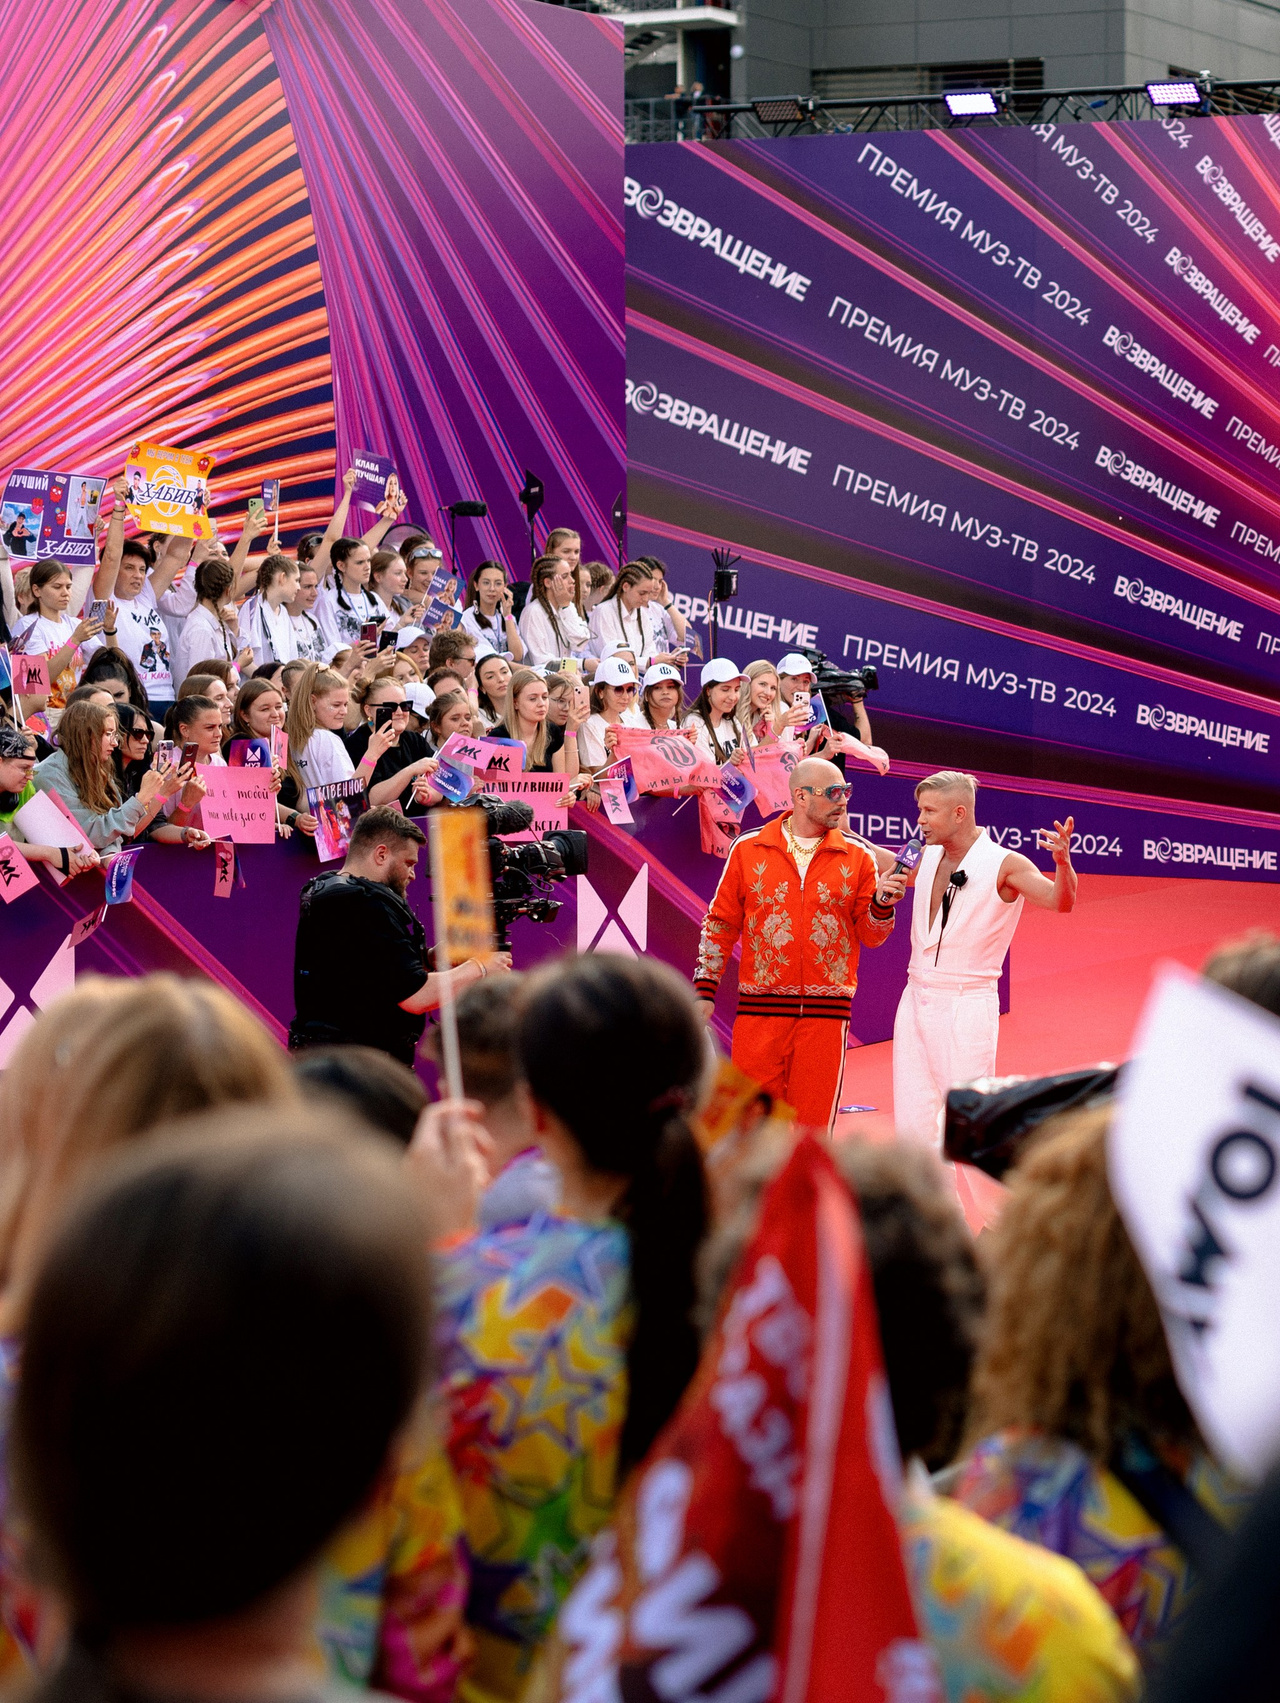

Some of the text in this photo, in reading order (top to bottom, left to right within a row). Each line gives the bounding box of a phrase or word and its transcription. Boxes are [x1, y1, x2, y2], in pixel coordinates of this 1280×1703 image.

[1158, 117, 1194, 149] 024
[1050, 134, 1120, 206] МУЗ-ТВ
[1116, 200, 1160, 244] 2024
[1163, 246, 1262, 345] ВОЗВРАЩЕНИЕ
[857, 142, 963, 231] ПРЕМИЯ
[960, 220, 1042, 290] МУЗ-ТВ
[1042, 281, 1093, 326] 2024
[1102, 325, 1219, 420] ВОЗВРАЩЕНИЕ
[624, 176, 812, 302] ВОЗВРАЩЕНИЕ
[828, 296, 940, 373] ПРЕМИЯ
[940, 359, 1027, 421] МУЗ-ТВ
[1028, 409, 1081, 451] 2024
[1095, 445, 1221, 528] ВОЗВРАЩЕНИЕ
[355, 459, 380, 473] КЛАВА
[8, 474, 50, 491] ЛУЧШИЙ
[136, 482, 197, 506] ХАБИБ
[37, 539, 94, 560] ХАБИБ
[832, 464, 947, 528] ПРЕМИЯ
[950, 511, 1040, 563] МУЗ-ТВ
[1043, 548, 1097, 585] 2024
[1113, 575, 1244, 642] ВОЗВРАЩЕНИЕ
[668, 590, 819, 649] ВРАЩЕНИЕ
[842, 634, 960, 682] ПРЕМИЯ
[965, 663, 1057, 704] МУЗ-ТВ
[1063, 687, 1117, 718] 2024
[1136, 703, 1271, 754] ВОЗВРАЩЕНИЕ
[511, 779, 564, 793] ГЛАВНЫЙ
[647, 775, 684, 789] ИМЫ
[848, 813, 924, 841] ПРЕМ
[1070, 833, 1123, 857] 2024
[1143, 836, 1278, 871] ВОЗВРАЩЕНИЕ
